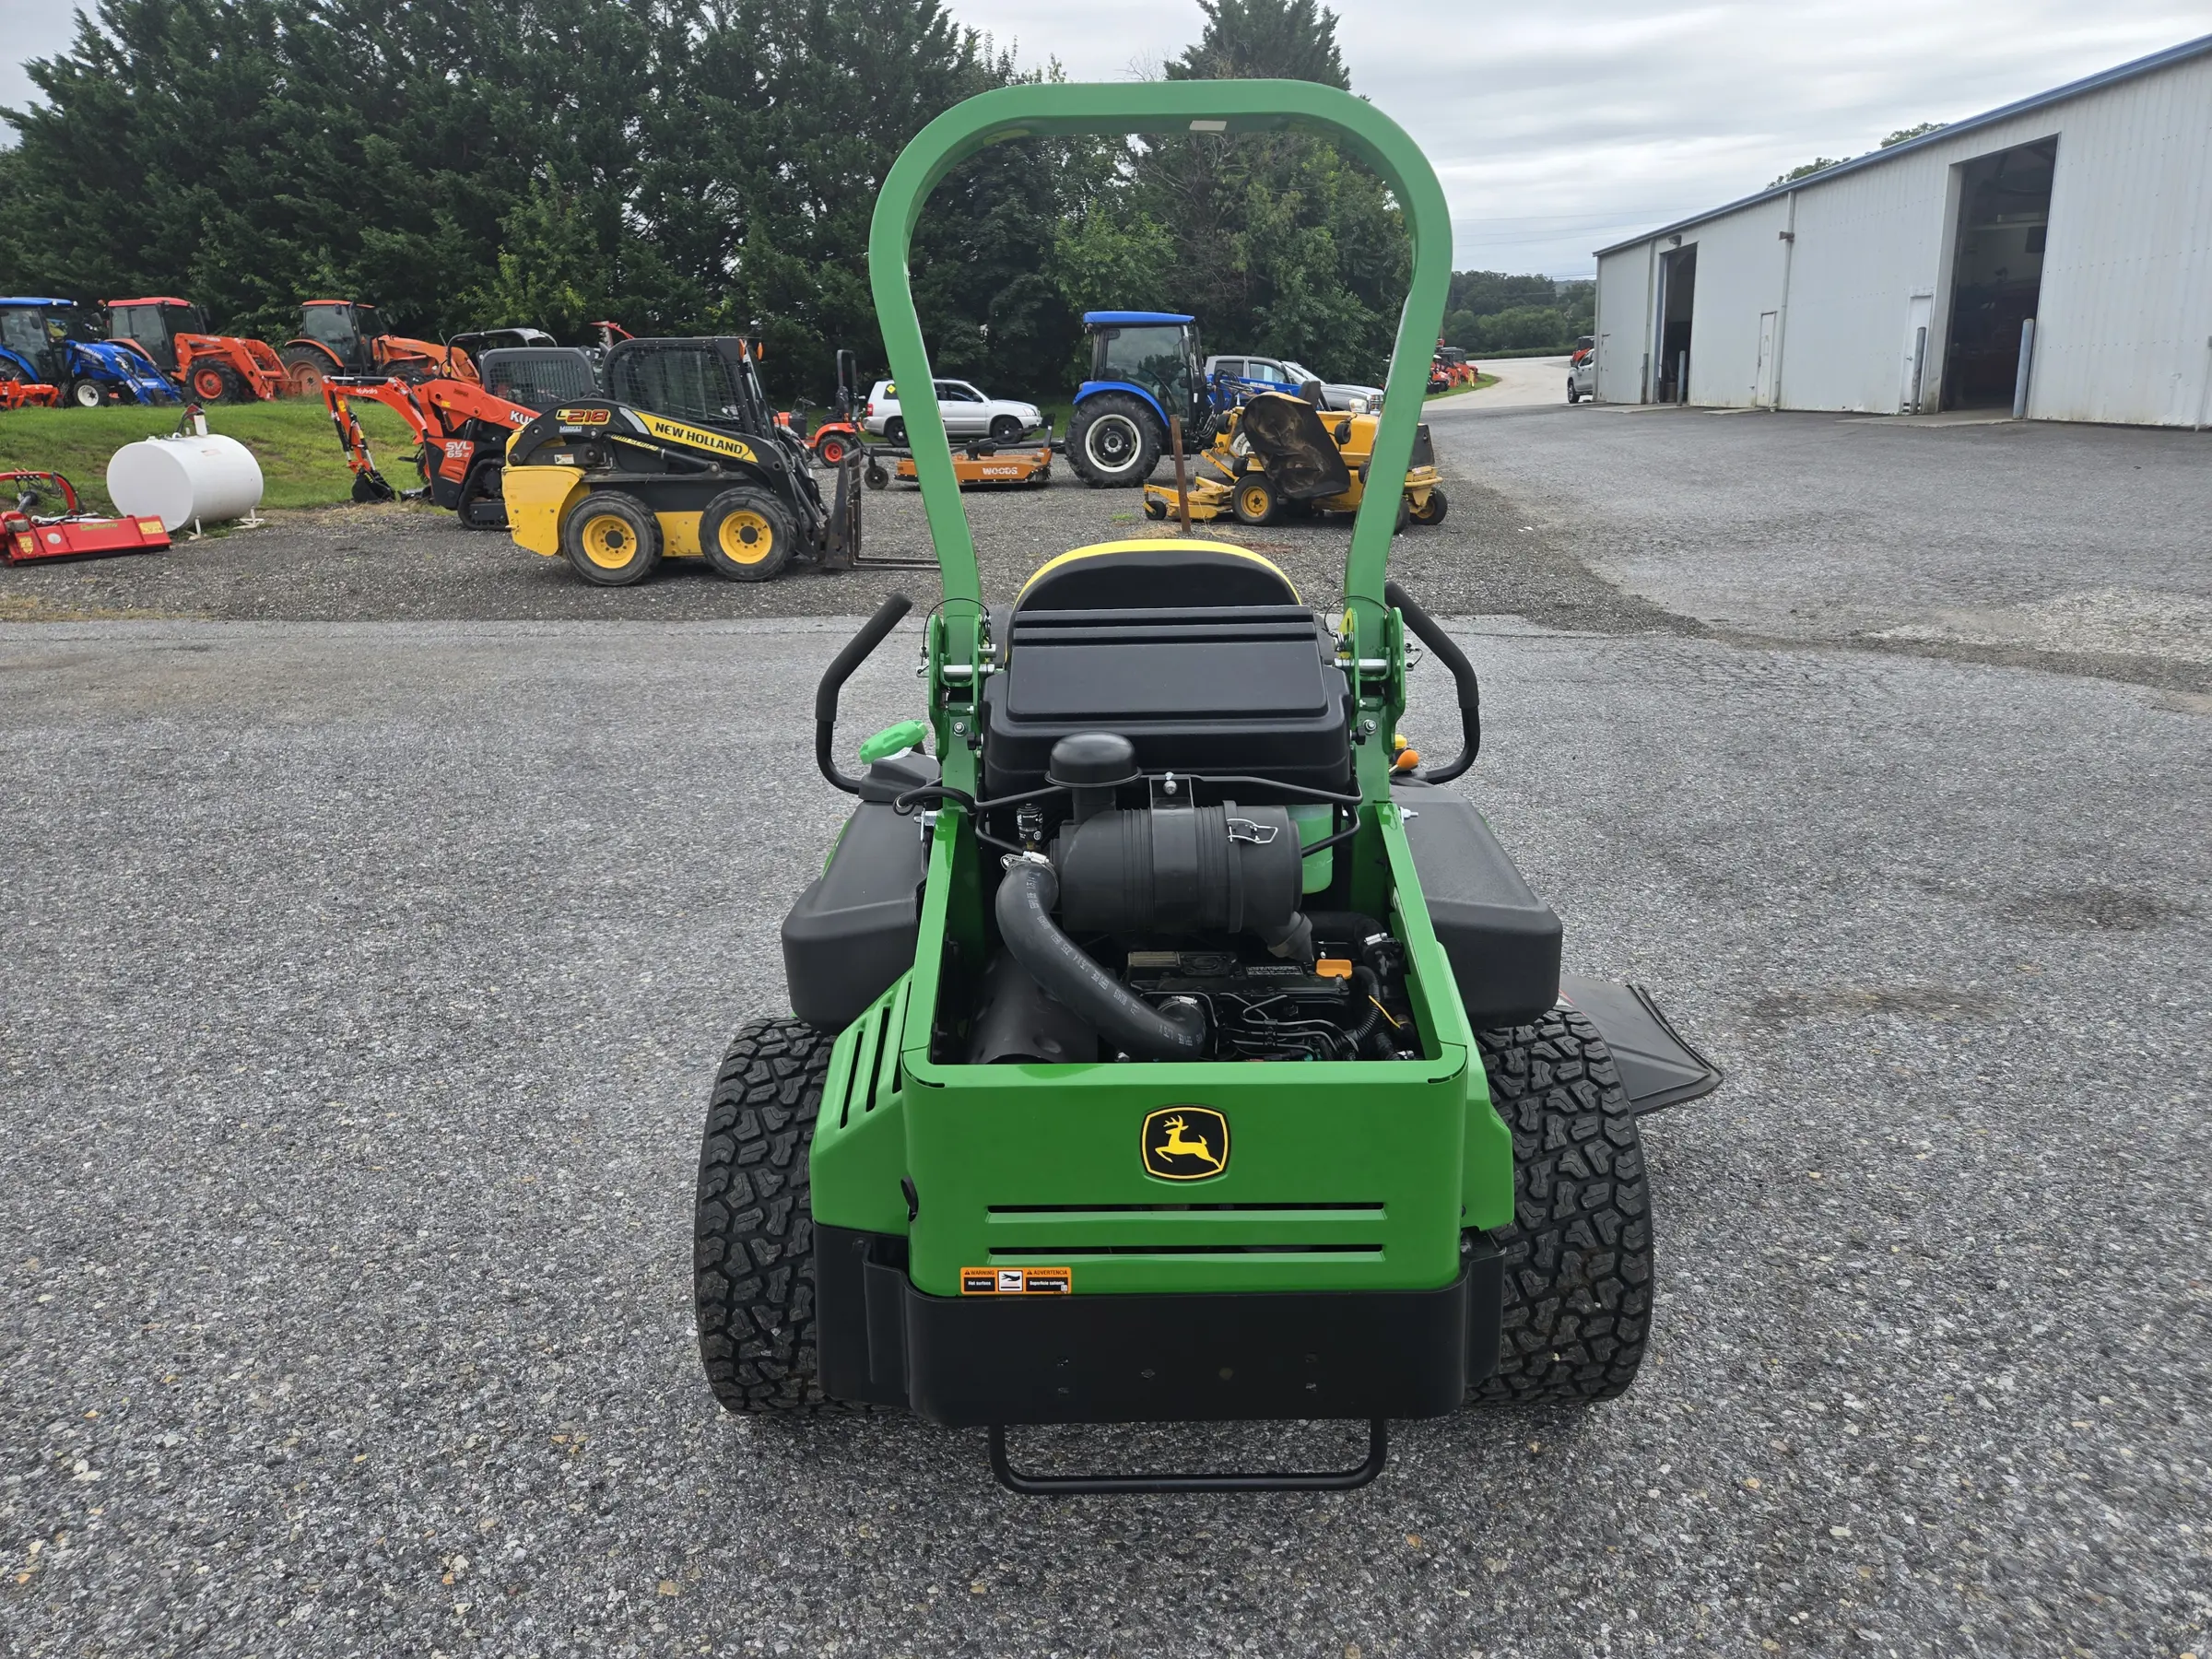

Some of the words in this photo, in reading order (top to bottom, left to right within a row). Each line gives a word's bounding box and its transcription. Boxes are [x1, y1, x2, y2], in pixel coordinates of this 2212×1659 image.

[557, 409, 608, 423] L218
[654, 422, 685, 438] NEW
[687, 430, 743, 454] HOLLAND
[445, 441, 472, 451] SVL
[982, 466, 1018, 475] WOODS
